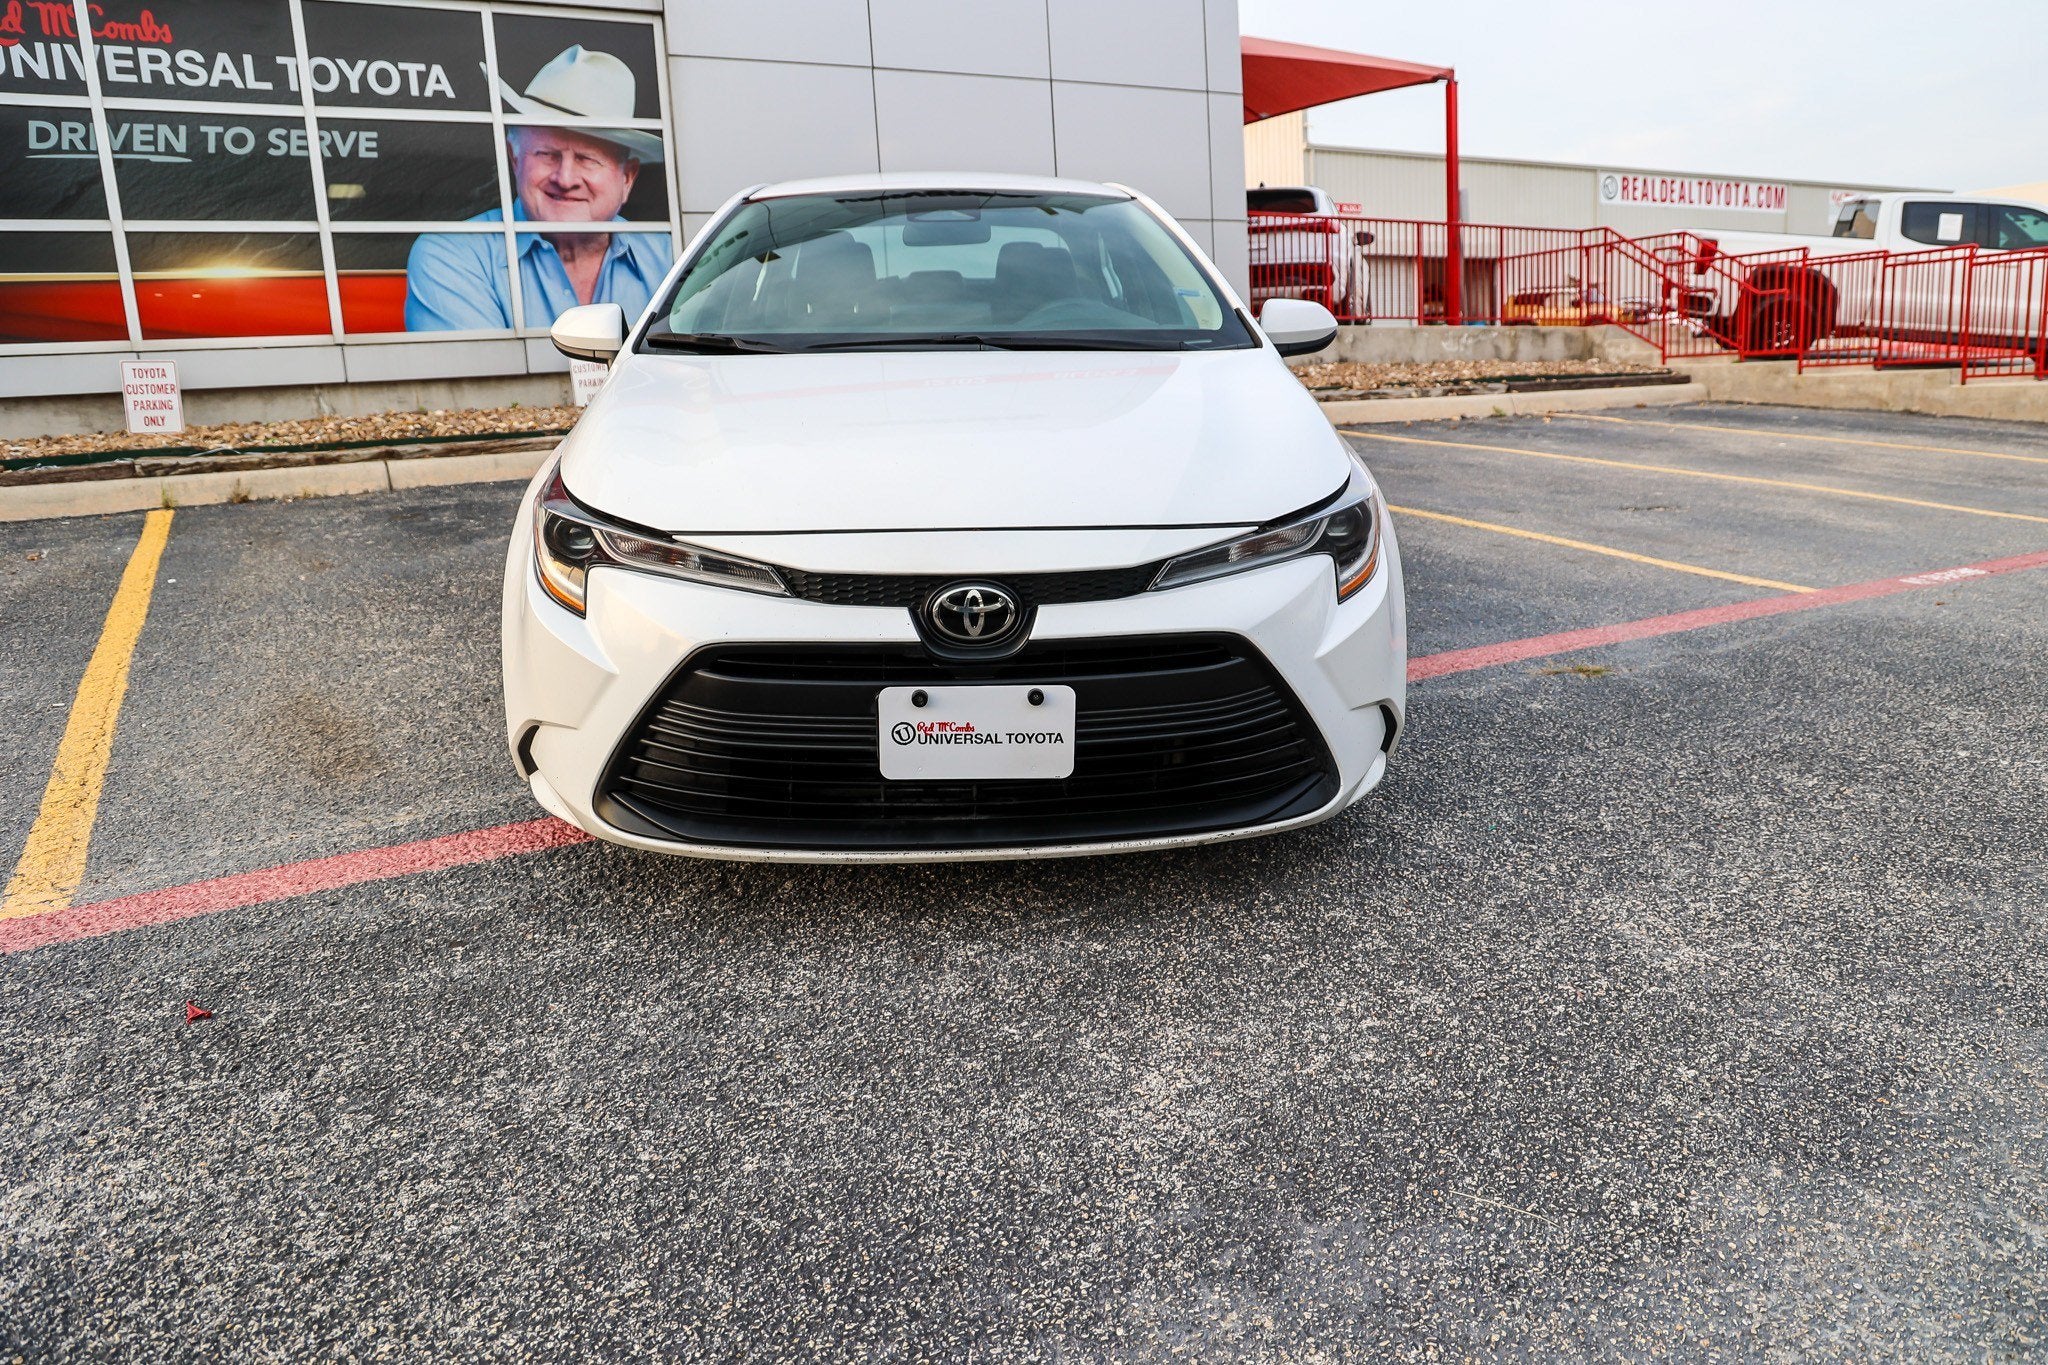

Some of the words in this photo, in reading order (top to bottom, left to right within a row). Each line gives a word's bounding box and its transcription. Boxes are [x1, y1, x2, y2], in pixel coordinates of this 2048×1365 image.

[276, 56, 456, 98] TOYOTA
[28, 120, 187, 153] DRIVEN
[200, 125, 256, 155] TO
[267, 127, 379, 158] SERVE
[1621, 176, 1785, 209] REALDEALTOYOTA.COM
[132, 367, 167, 379] TOYOTA
[572, 362, 606, 374] CUSTOME
[125, 383, 176, 395] CUSTOMER
[133, 400, 173, 411] PARKING
[143, 415, 166, 427] ONLY
[917, 721, 935, 735] Red
[936, 721, 975, 732] McCombs
[917, 733, 1003, 745] UNIVERSAL
[1006, 732, 1065, 744] TOYOTA
